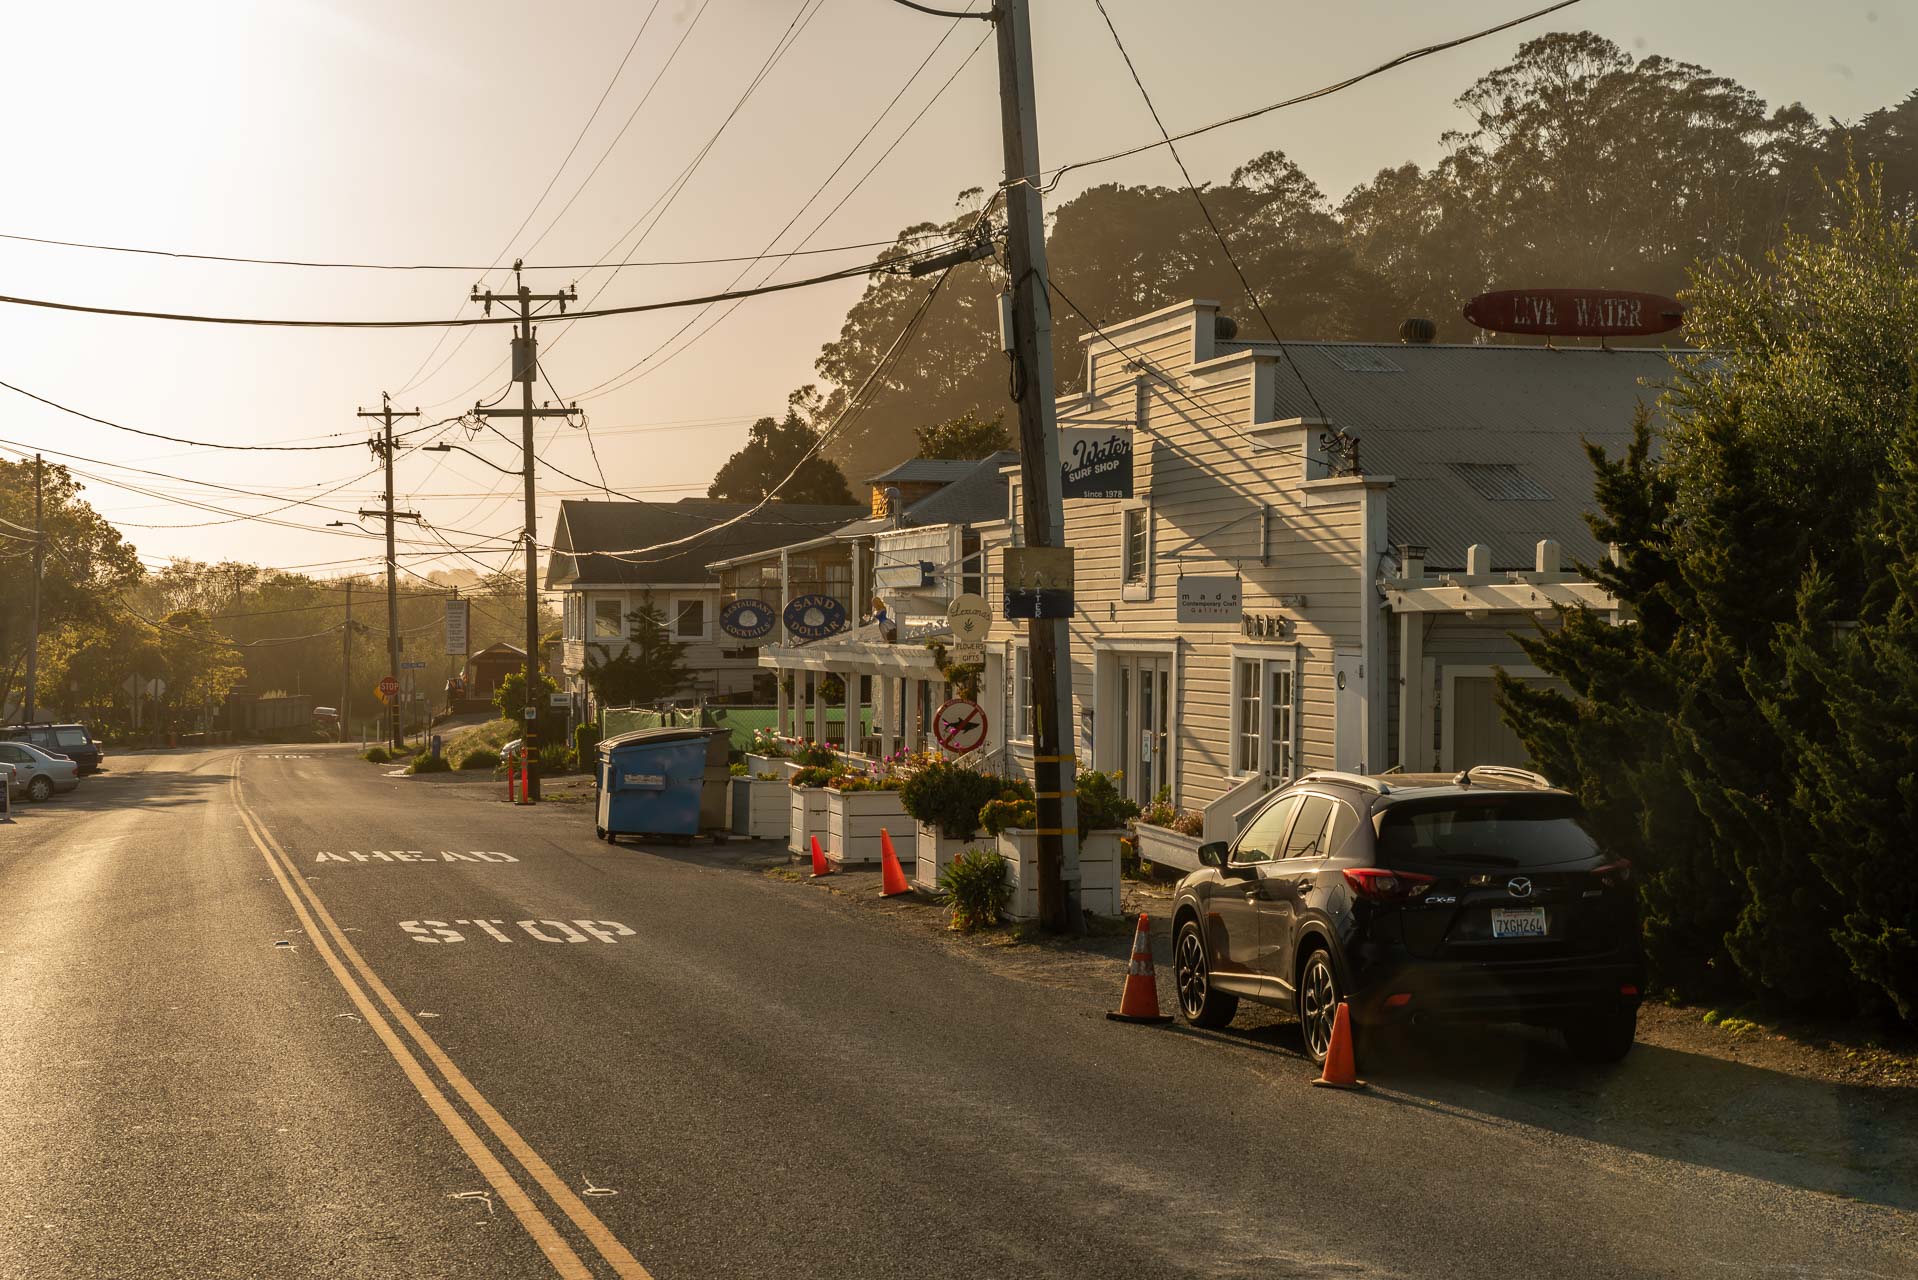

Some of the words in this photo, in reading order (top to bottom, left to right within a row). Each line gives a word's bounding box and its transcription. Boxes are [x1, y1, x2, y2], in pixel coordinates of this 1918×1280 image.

[1514, 297, 1557, 326] LIVE
[1575, 298, 1642, 328] WATER
[1073, 435, 1133, 468] Water
[1069, 466, 1092, 482] SURF
[1095, 460, 1120, 474] SHOP
[1105, 490, 1122, 498] 1978
[723, 600, 773, 619] RESTAURANT
[793, 597, 835, 611] SAND
[726, 622, 770, 637] COCKTAILS
[790, 619, 840, 636] DOLLAR
[381, 682, 399, 690] STOP
[315, 850, 520, 863] AHEAD
[399, 919, 637, 944] STOP
[1496, 918, 1542, 933] 7XGH264
